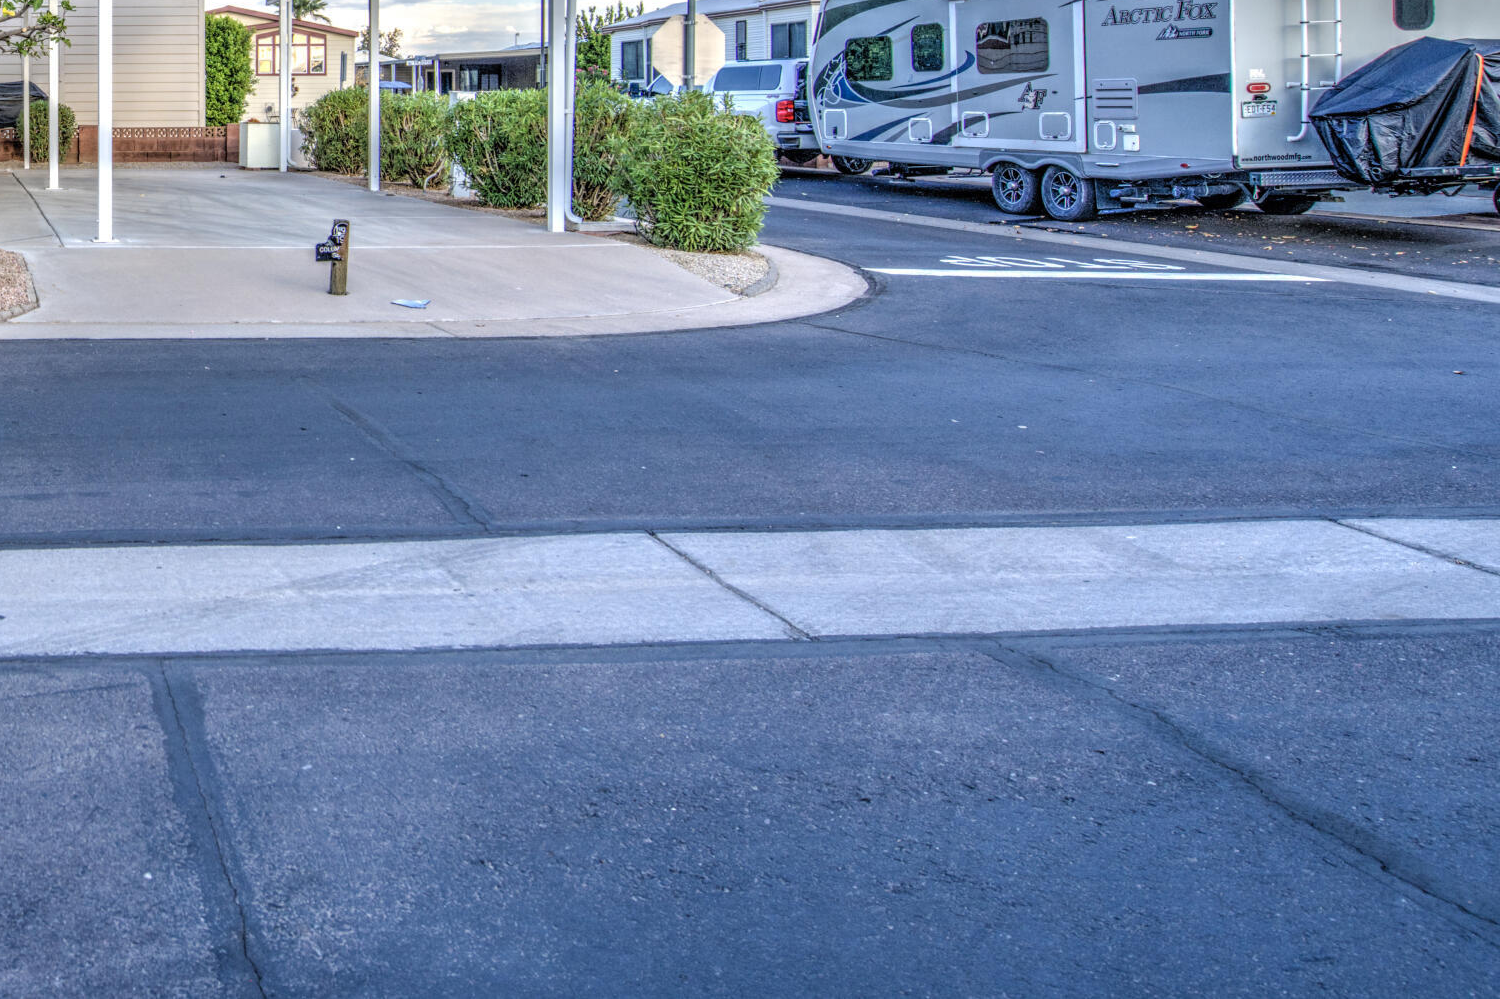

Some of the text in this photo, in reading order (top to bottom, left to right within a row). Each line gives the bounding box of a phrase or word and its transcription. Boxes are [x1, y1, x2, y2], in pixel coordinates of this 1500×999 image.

[1101, 5, 1173, 26] ARCTIC
[1241, 153, 1312, 161] www.northwoodmfg.com
[939, 255, 1186, 270] STOP
